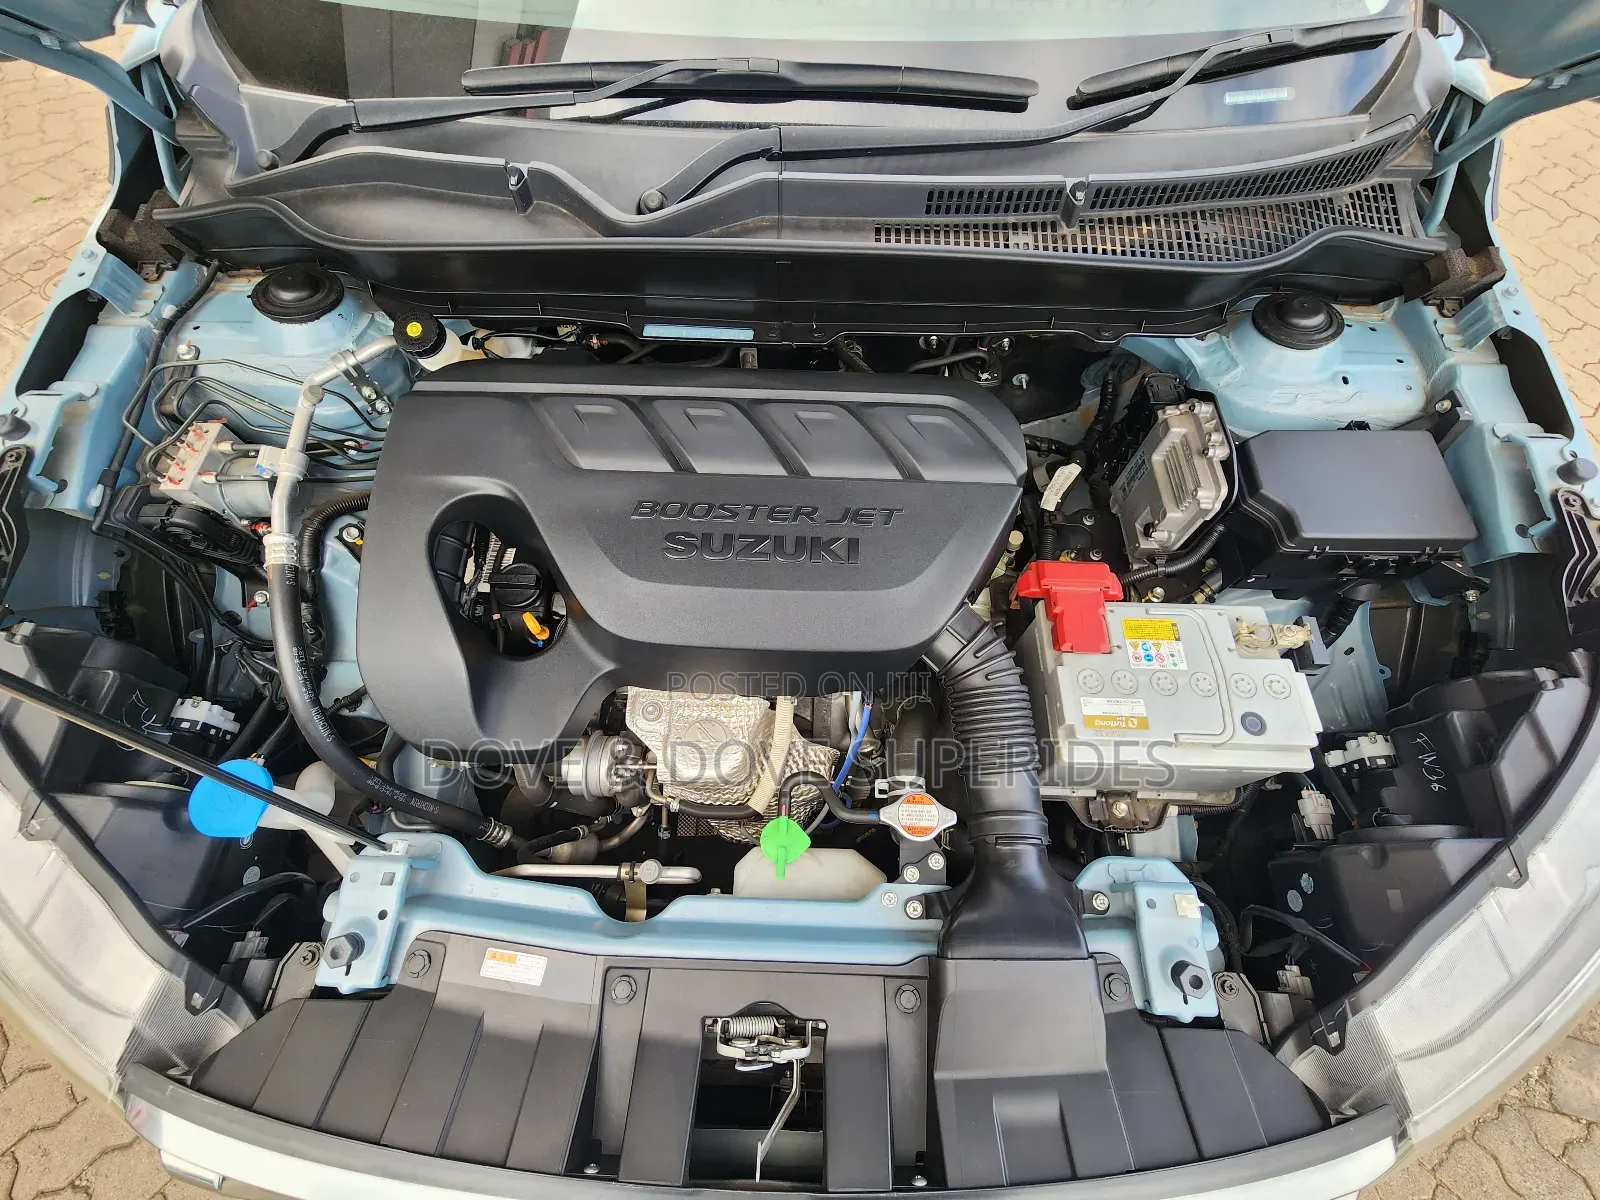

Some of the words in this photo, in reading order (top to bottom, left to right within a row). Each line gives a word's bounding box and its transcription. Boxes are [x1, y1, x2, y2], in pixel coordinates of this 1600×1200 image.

[631, 500, 820, 525] BOOSTER
[825, 507, 904, 527] JET
[663, 531, 861, 564] SUZUKI
